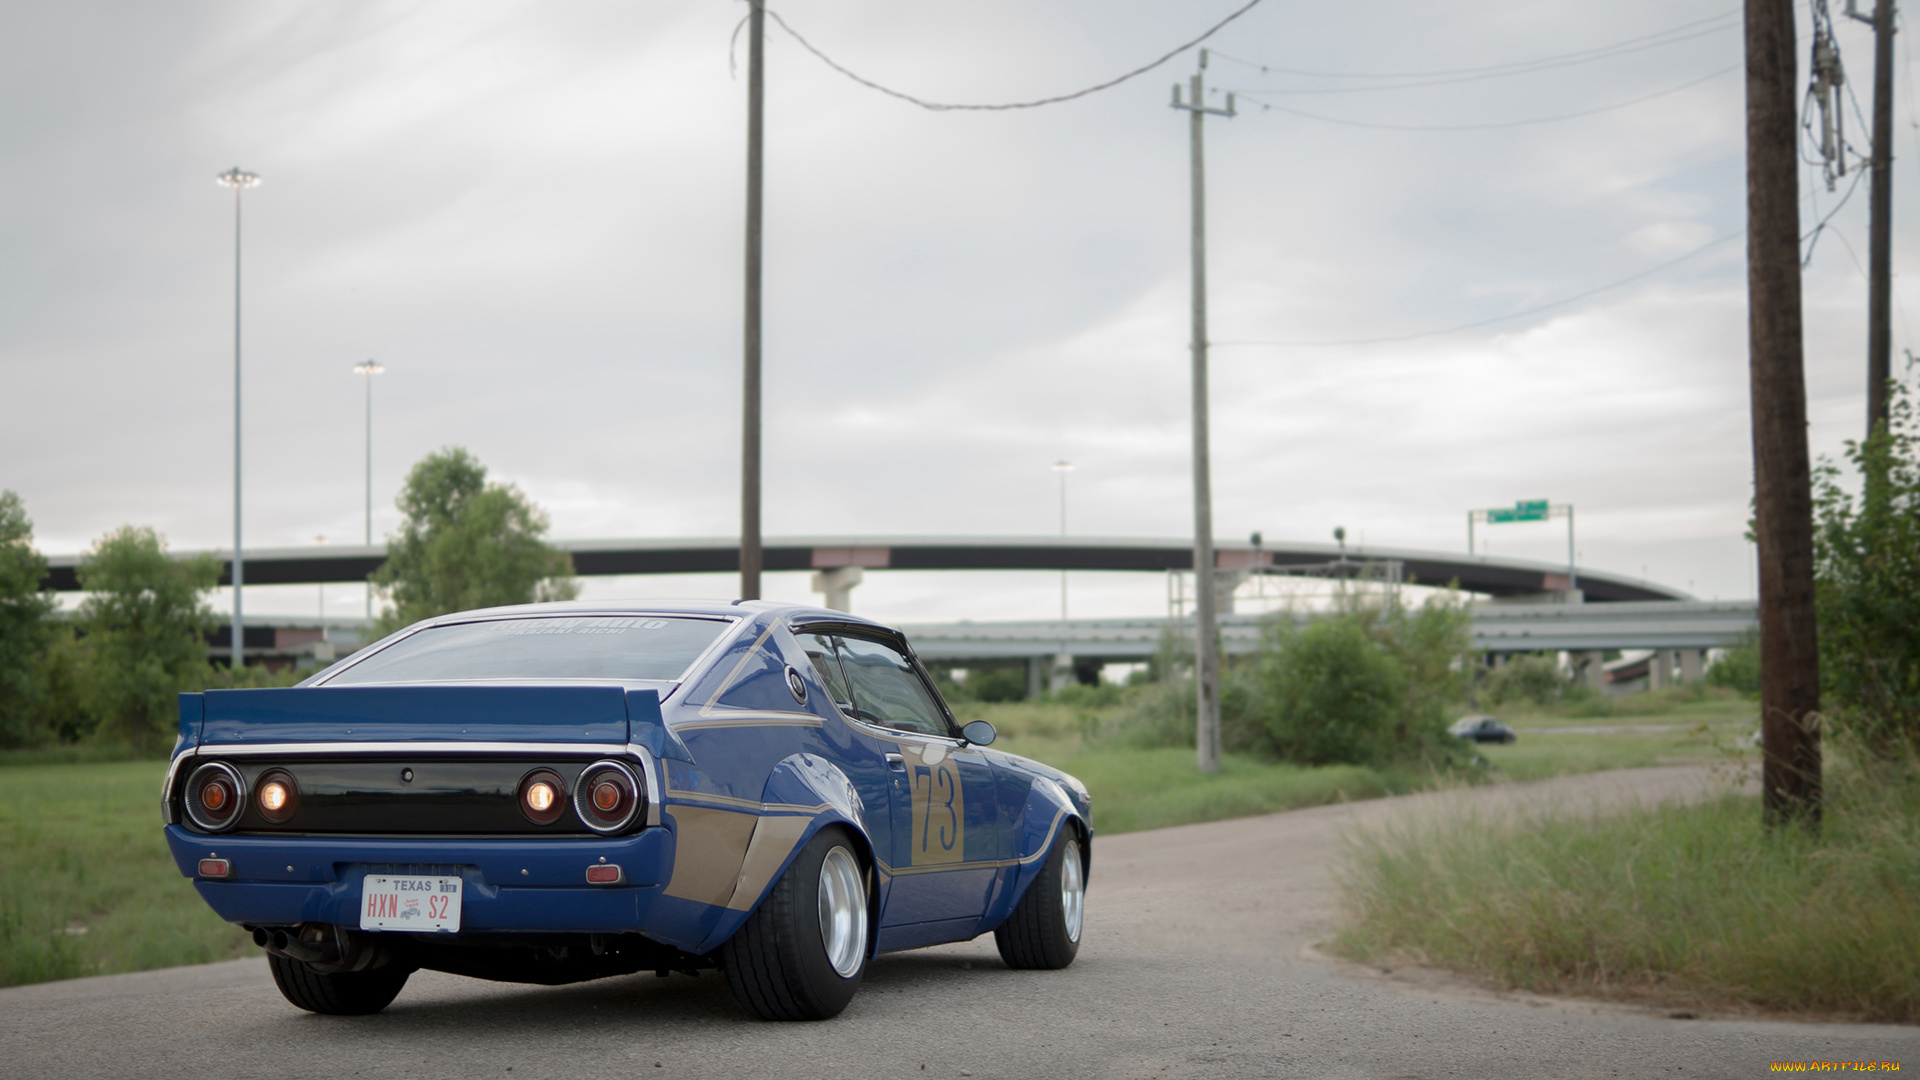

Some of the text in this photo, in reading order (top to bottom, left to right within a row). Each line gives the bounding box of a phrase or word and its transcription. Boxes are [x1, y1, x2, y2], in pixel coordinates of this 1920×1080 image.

[585, 618, 668, 629] AUTO
[914, 765, 957, 853] 73
[393, 880, 432, 891] TEXAS
[367, 893, 398, 918] HXN
[428, 895, 449, 919] S2
